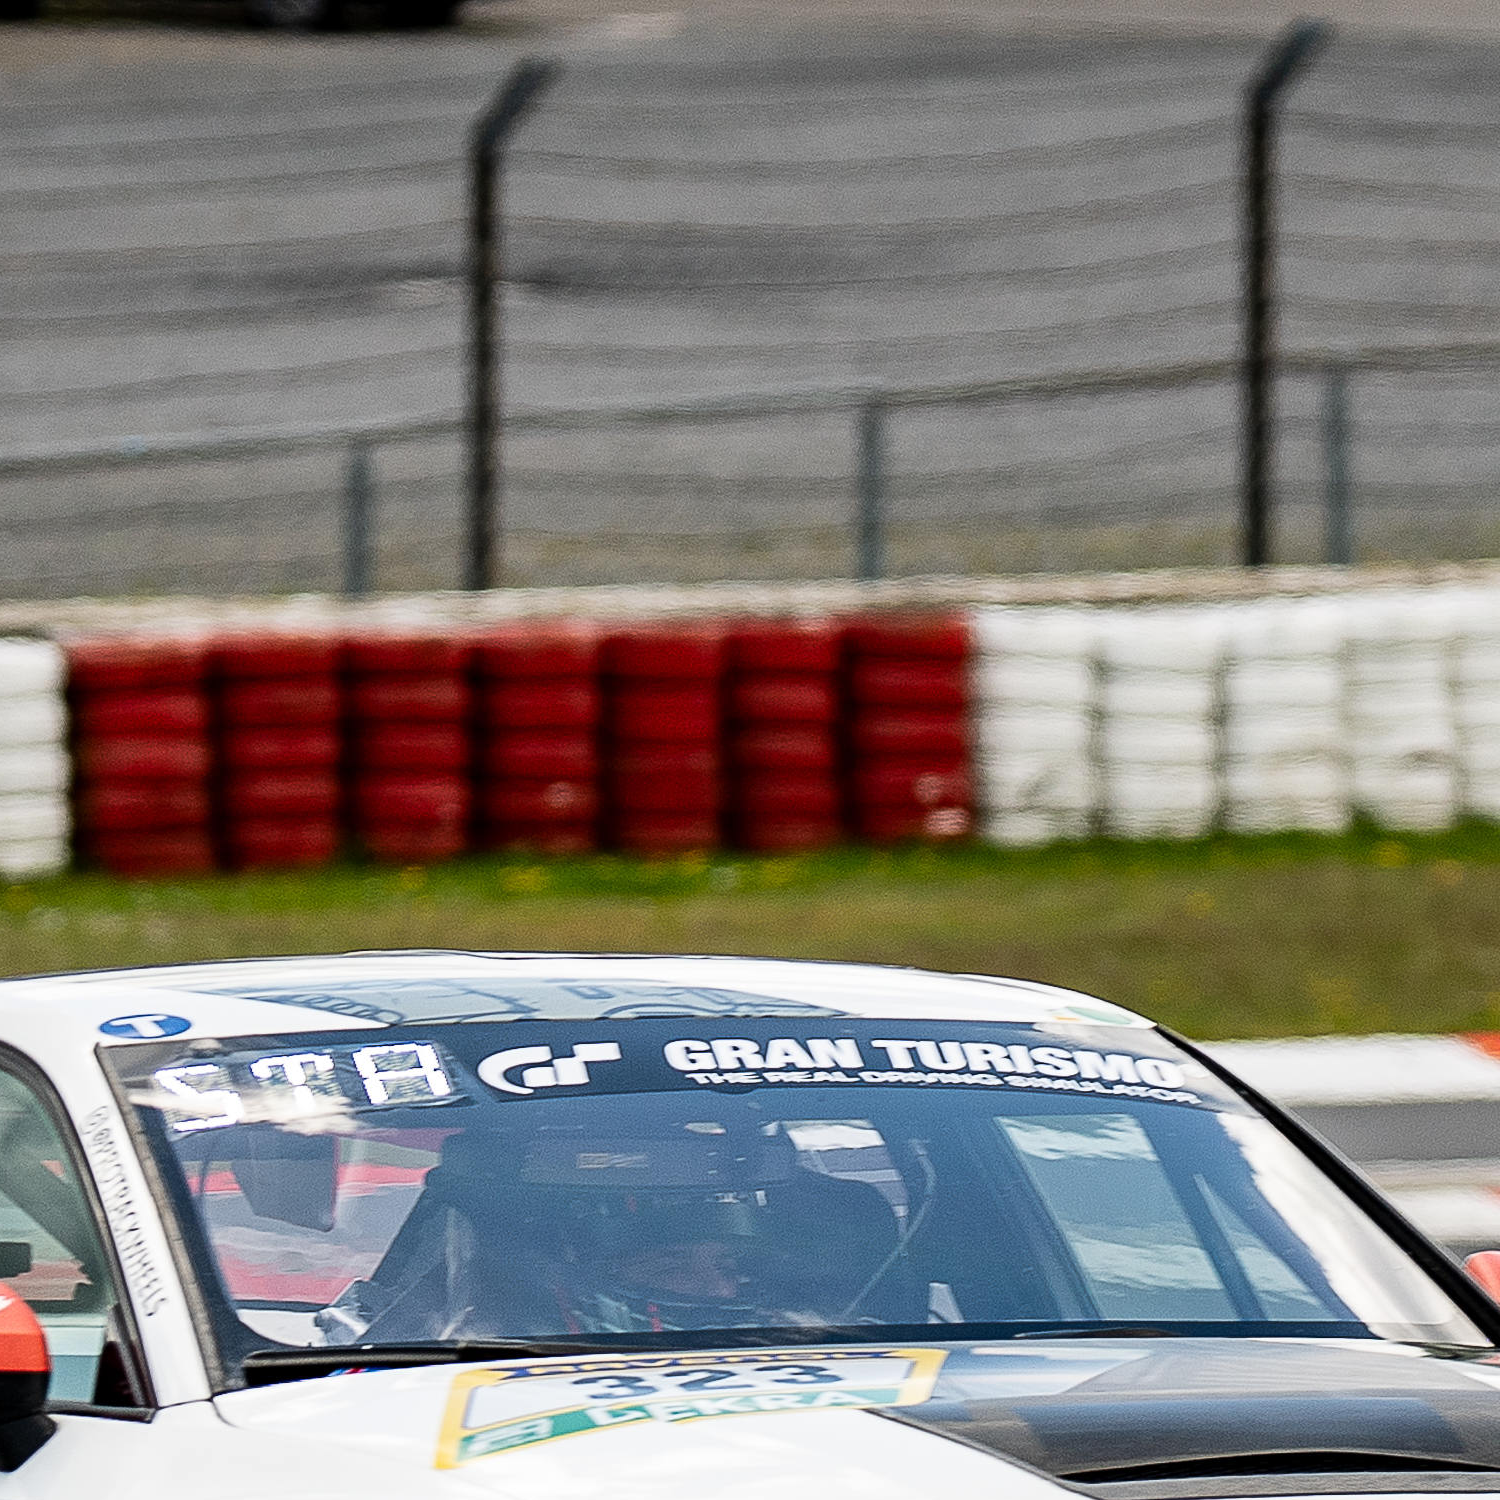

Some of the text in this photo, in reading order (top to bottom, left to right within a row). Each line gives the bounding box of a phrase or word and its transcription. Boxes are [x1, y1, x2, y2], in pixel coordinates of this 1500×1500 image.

[663, 1037, 1187, 1089] GRAN TURISMO
[684, 1071, 1202, 1105] THE REAL DRIVING SIMULATOR
[571, 1363, 846, 1401] 323
[588, 1389, 870, 1424] DEKRA
